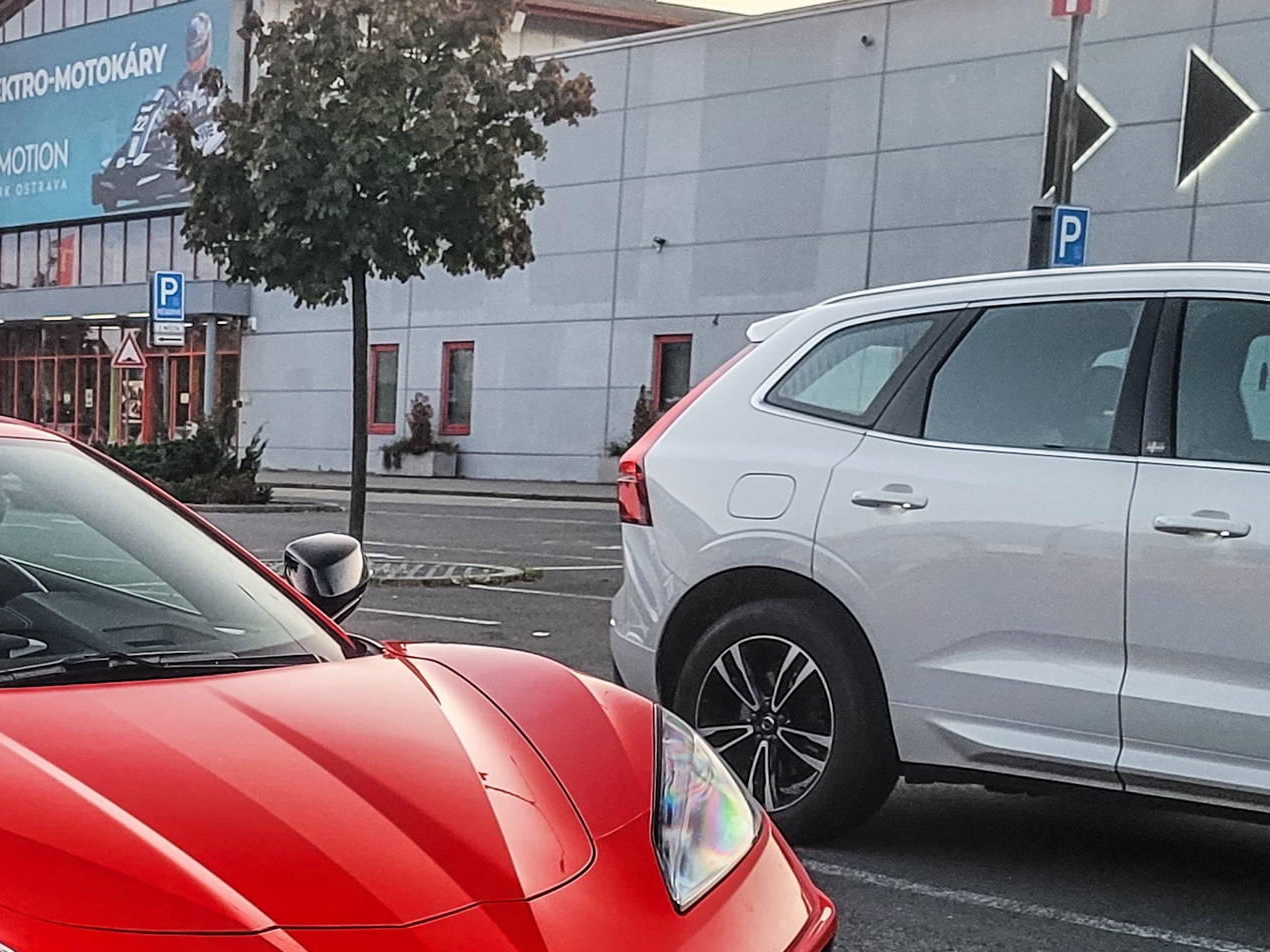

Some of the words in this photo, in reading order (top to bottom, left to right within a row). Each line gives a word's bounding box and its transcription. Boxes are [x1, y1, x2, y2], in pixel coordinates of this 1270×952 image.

[15, 179, 68, 196] OSTRAVA
[1059, 215, 1081, 258] P
[161, 277, 179, 306] P
